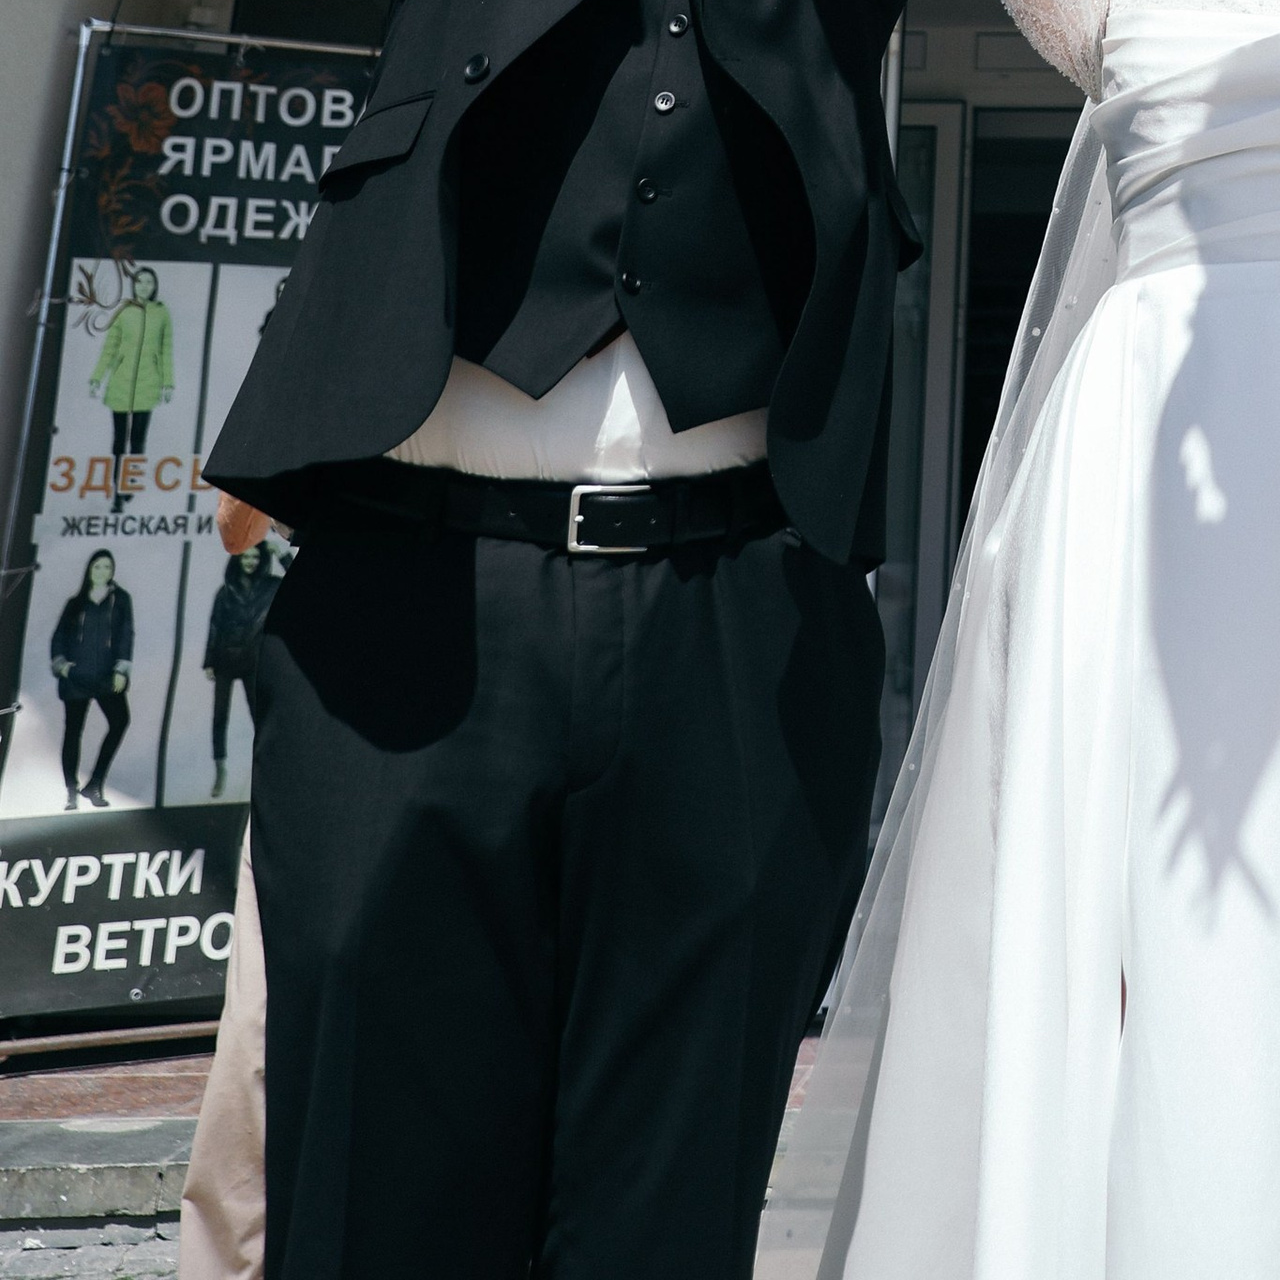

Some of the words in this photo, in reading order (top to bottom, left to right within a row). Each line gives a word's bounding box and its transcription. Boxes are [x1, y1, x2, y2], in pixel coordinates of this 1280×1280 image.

[169, 76, 367, 128] ОПТОВ
[50, 455, 218, 500] ЗДЕСЬ
[61, 515, 189, 538] ЖЕНСКАЯ
[197, 515, 214, 535] И
[0, 848, 206, 908] КУРТКИ
[51, 911, 236, 975] ВЕТРО
